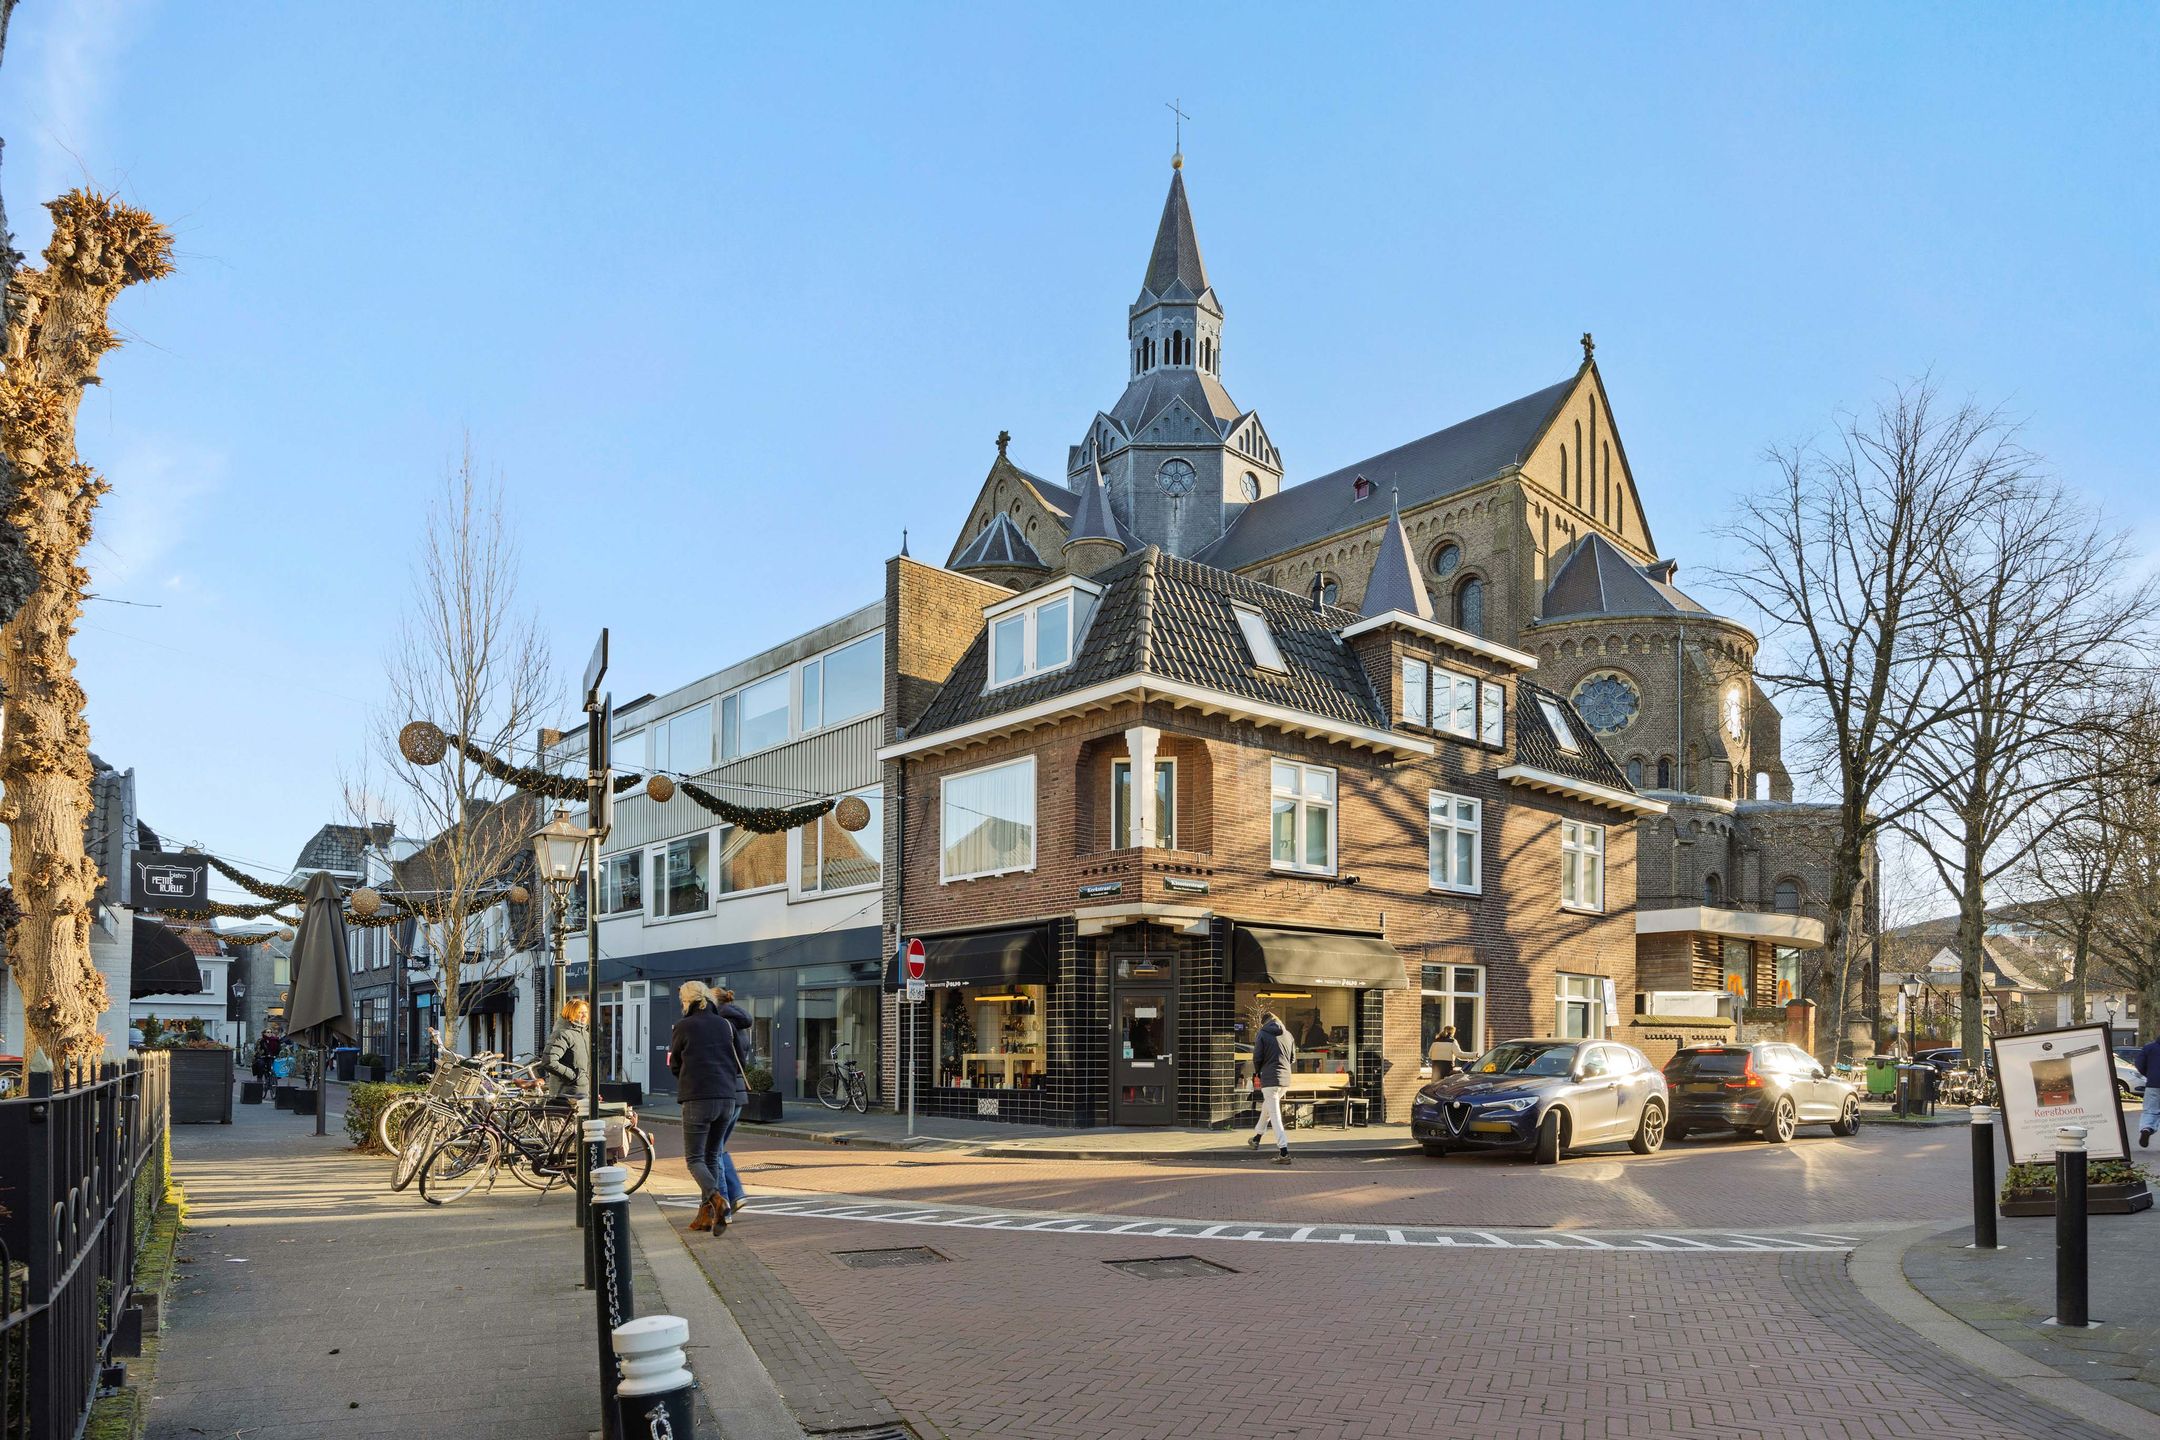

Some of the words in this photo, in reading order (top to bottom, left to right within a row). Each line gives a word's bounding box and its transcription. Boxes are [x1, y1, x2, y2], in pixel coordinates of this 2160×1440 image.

[169, 871, 187, 879] bistro
[152, 876, 173, 885] PETITE
[160, 885, 183, 893] RUELLE
[2034, 1106, 2085, 1118] Kerstboom
